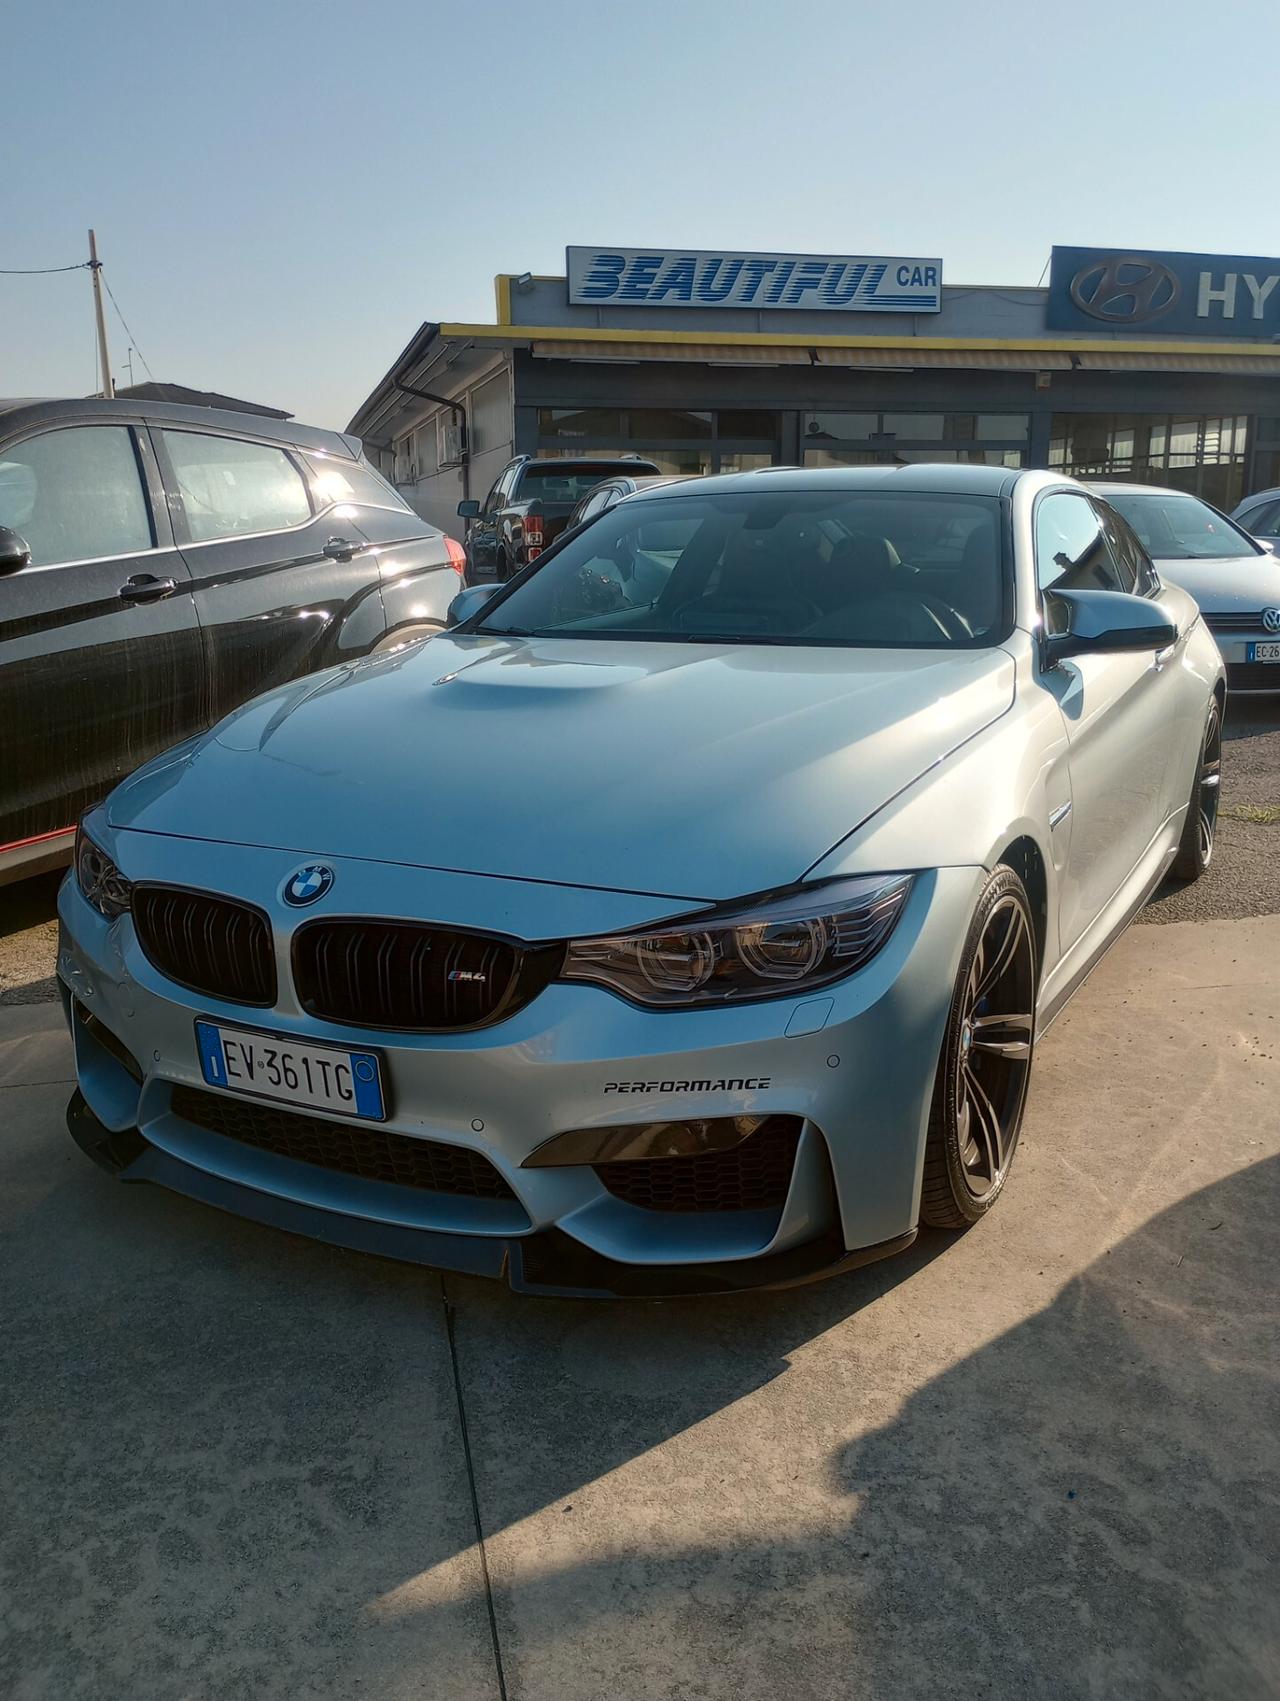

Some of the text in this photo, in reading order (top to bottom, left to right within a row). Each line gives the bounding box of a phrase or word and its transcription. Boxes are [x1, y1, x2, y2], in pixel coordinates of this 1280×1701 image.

[575, 254, 937, 305] BEAUTIFUL CAR
[603, 1077, 771, 1094] PERFORMANCE
